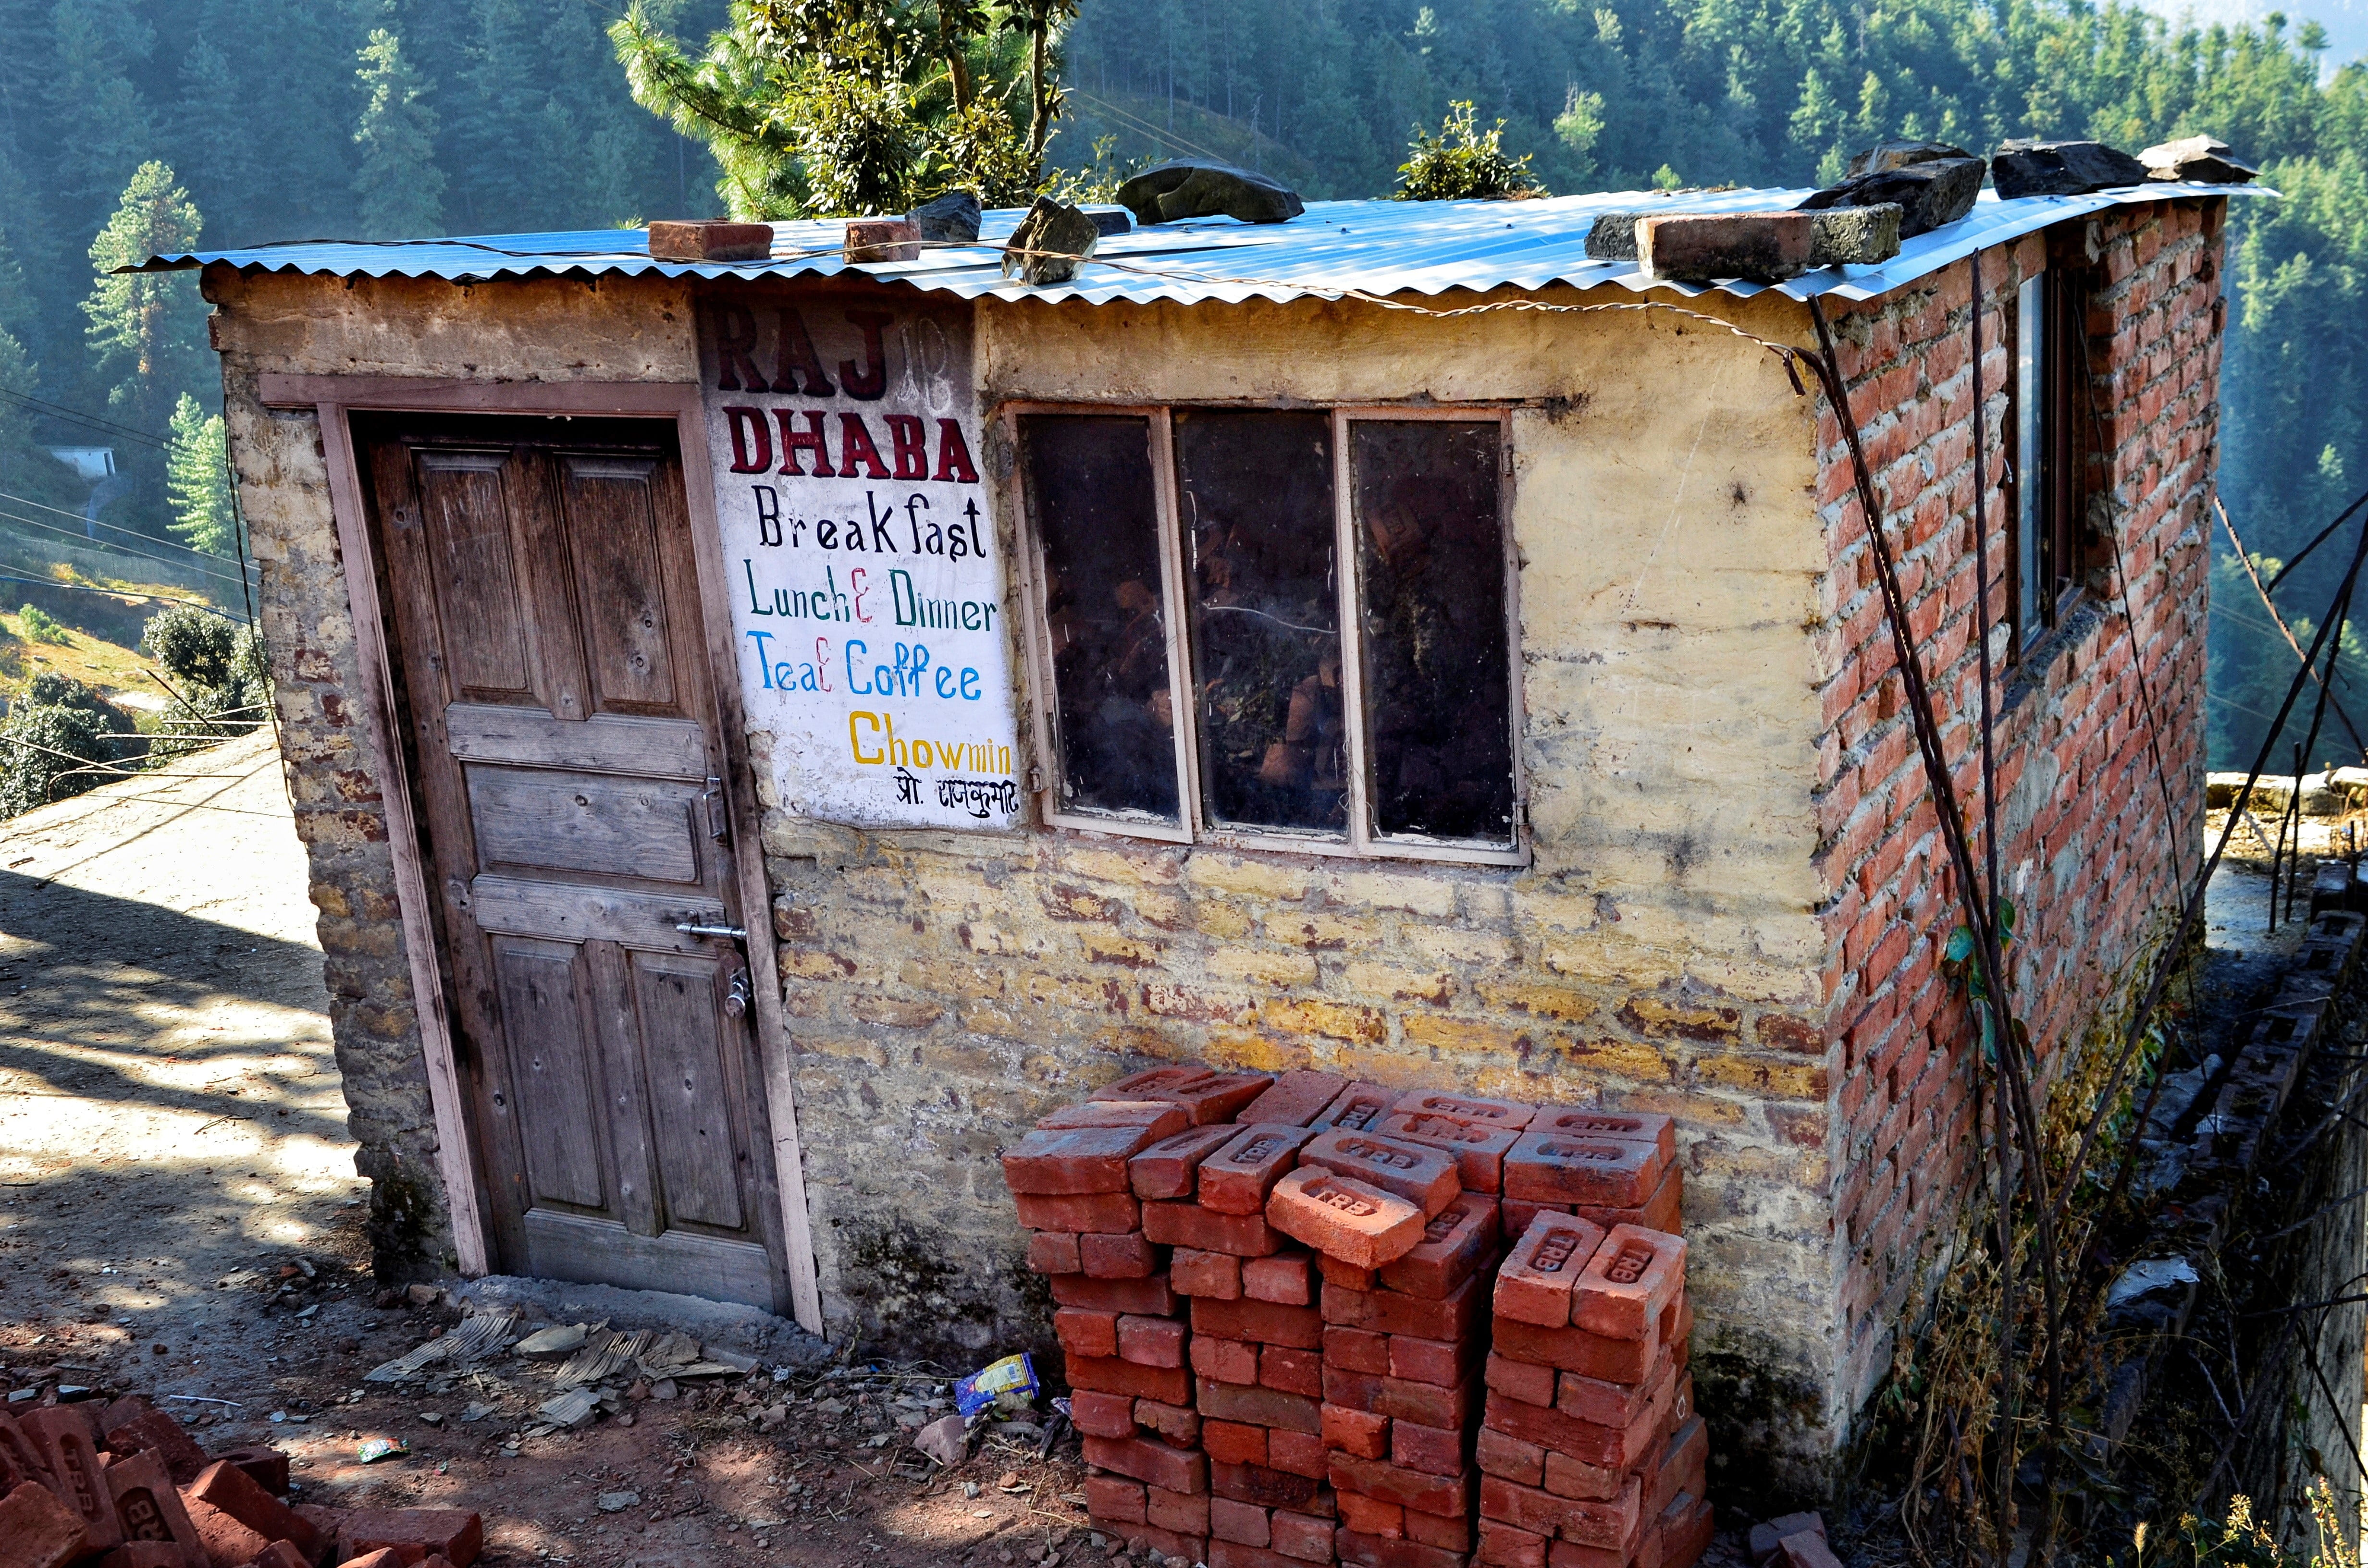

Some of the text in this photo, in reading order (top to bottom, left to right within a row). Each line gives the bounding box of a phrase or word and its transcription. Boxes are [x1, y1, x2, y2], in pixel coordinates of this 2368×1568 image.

[707, 302, 893, 401] RAJ
[722, 406, 979, 483] DHABA
[888, 569, 997, 631] Dinner
[845, 639, 981, 700] Coffee
[849, 711, 1011, 774] Chowmin
[893, 767, 1019, 818] प्रो. राजकुमार
[1535, 1237, 1575, 1271] TRB
[1612, 1250, 1652, 1283] TRB
[64, 1449, 93, 1512] TRB
